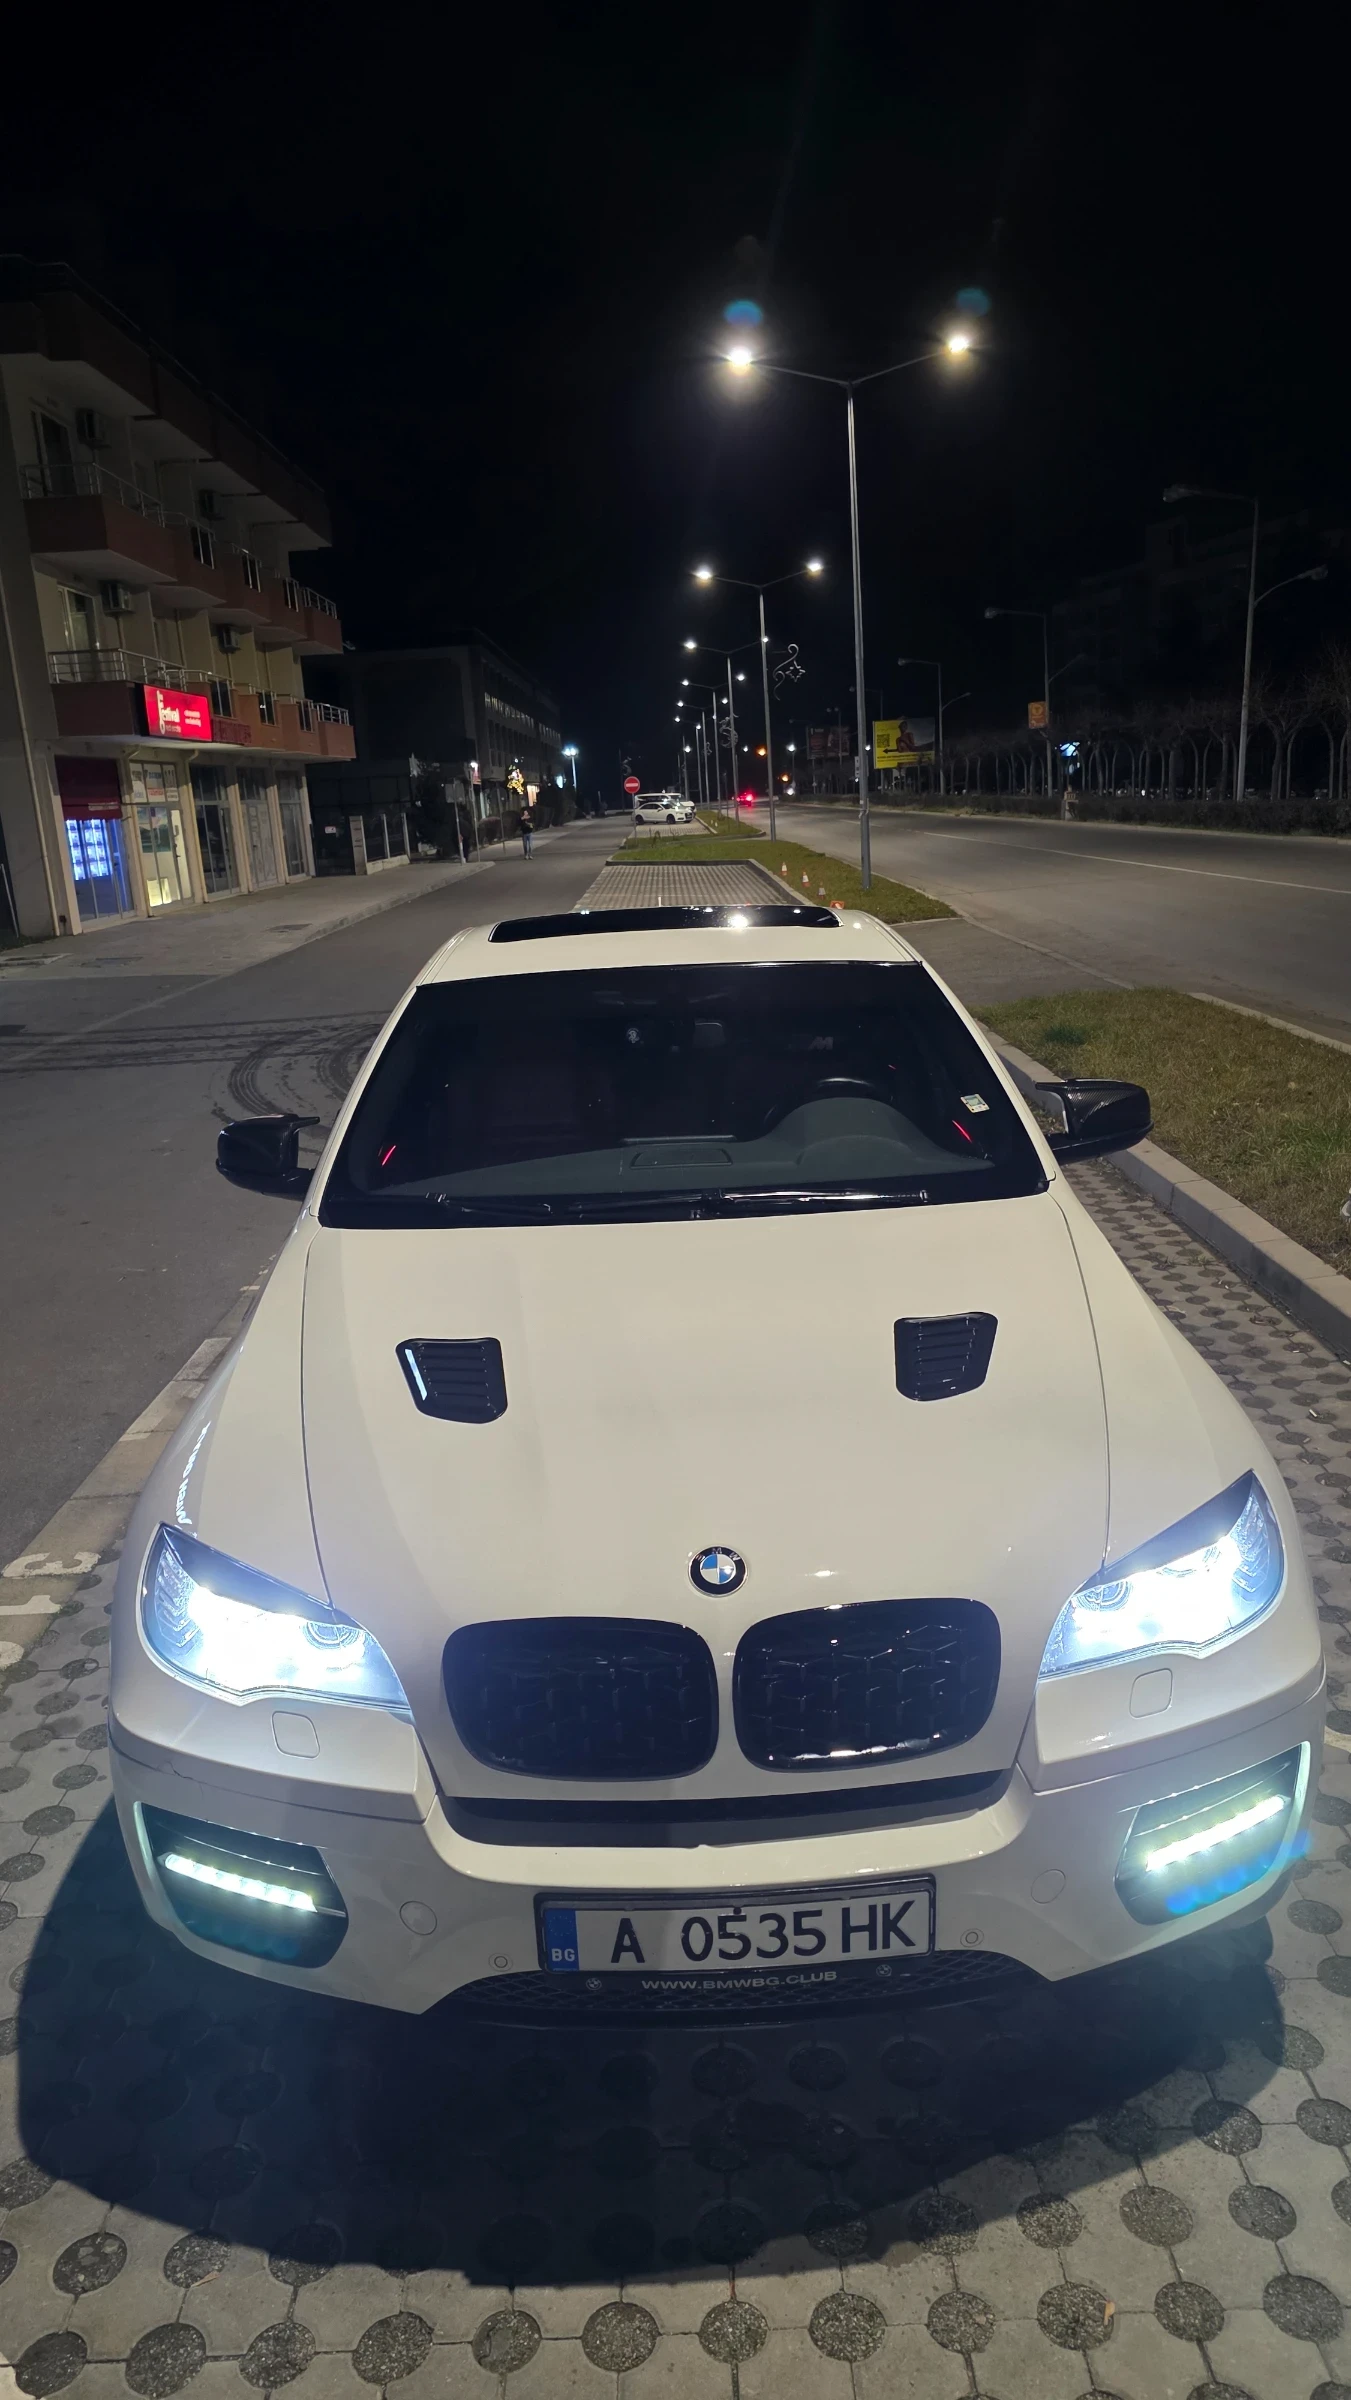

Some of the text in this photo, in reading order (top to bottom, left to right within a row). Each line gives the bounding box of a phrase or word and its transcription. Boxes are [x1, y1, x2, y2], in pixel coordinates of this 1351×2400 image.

[610, 1900, 916, 1963] A 0535 HK
[551, 1948, 576, 1962] BG
[641, 1971, 838, 1990] WWW.BMWBG.CLUB
